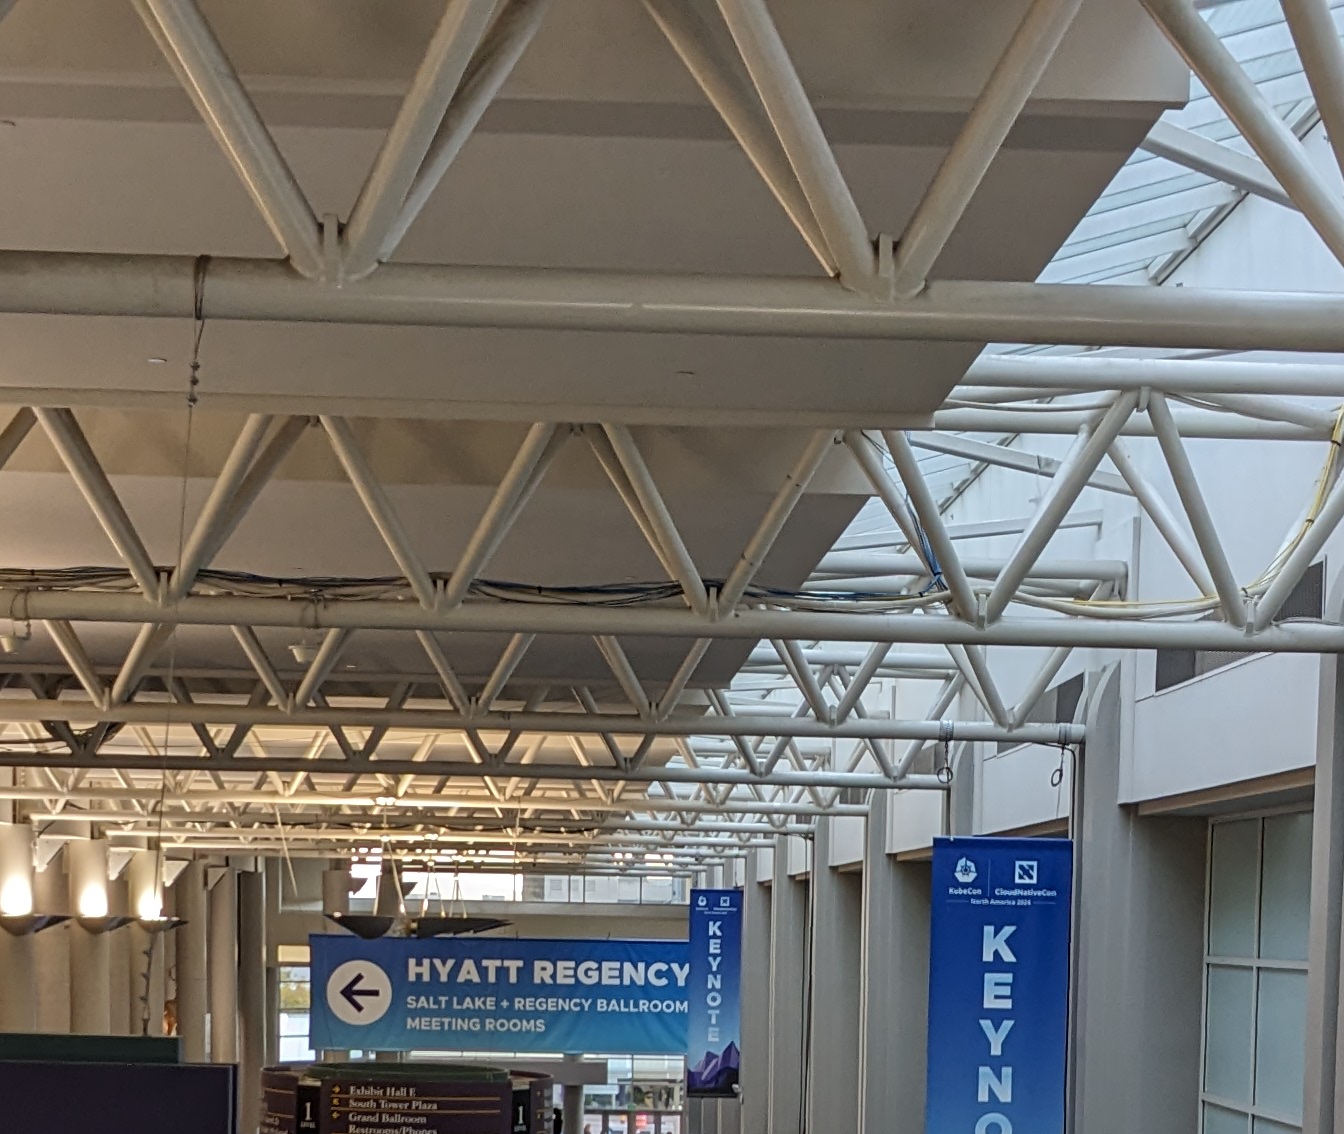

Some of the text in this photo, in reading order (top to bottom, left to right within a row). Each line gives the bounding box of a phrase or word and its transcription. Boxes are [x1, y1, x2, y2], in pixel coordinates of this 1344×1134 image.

[408, 957, 690, 987] HYATT REGENCY
[707, 920, 723, 1042] KEYNOTE
[406, 994, 447, 1012] SALT
[453, 995, 496, 1012] LAKE
[514, 996, 591, 1014] REGENCY
[406, 1016, 546, 1034] MEETING ROOMS
[349, 1085, 384, 1097] Exhibit
[387, 1086, 407, 1097] Hall
[304, 1101, 312, 1121] 1
[349, 1098, 438, 1110] South Tower Plaza
[348, 1111, 426, 1124] Grand Ballroom
[518, 1105, 524, 1124] 1
